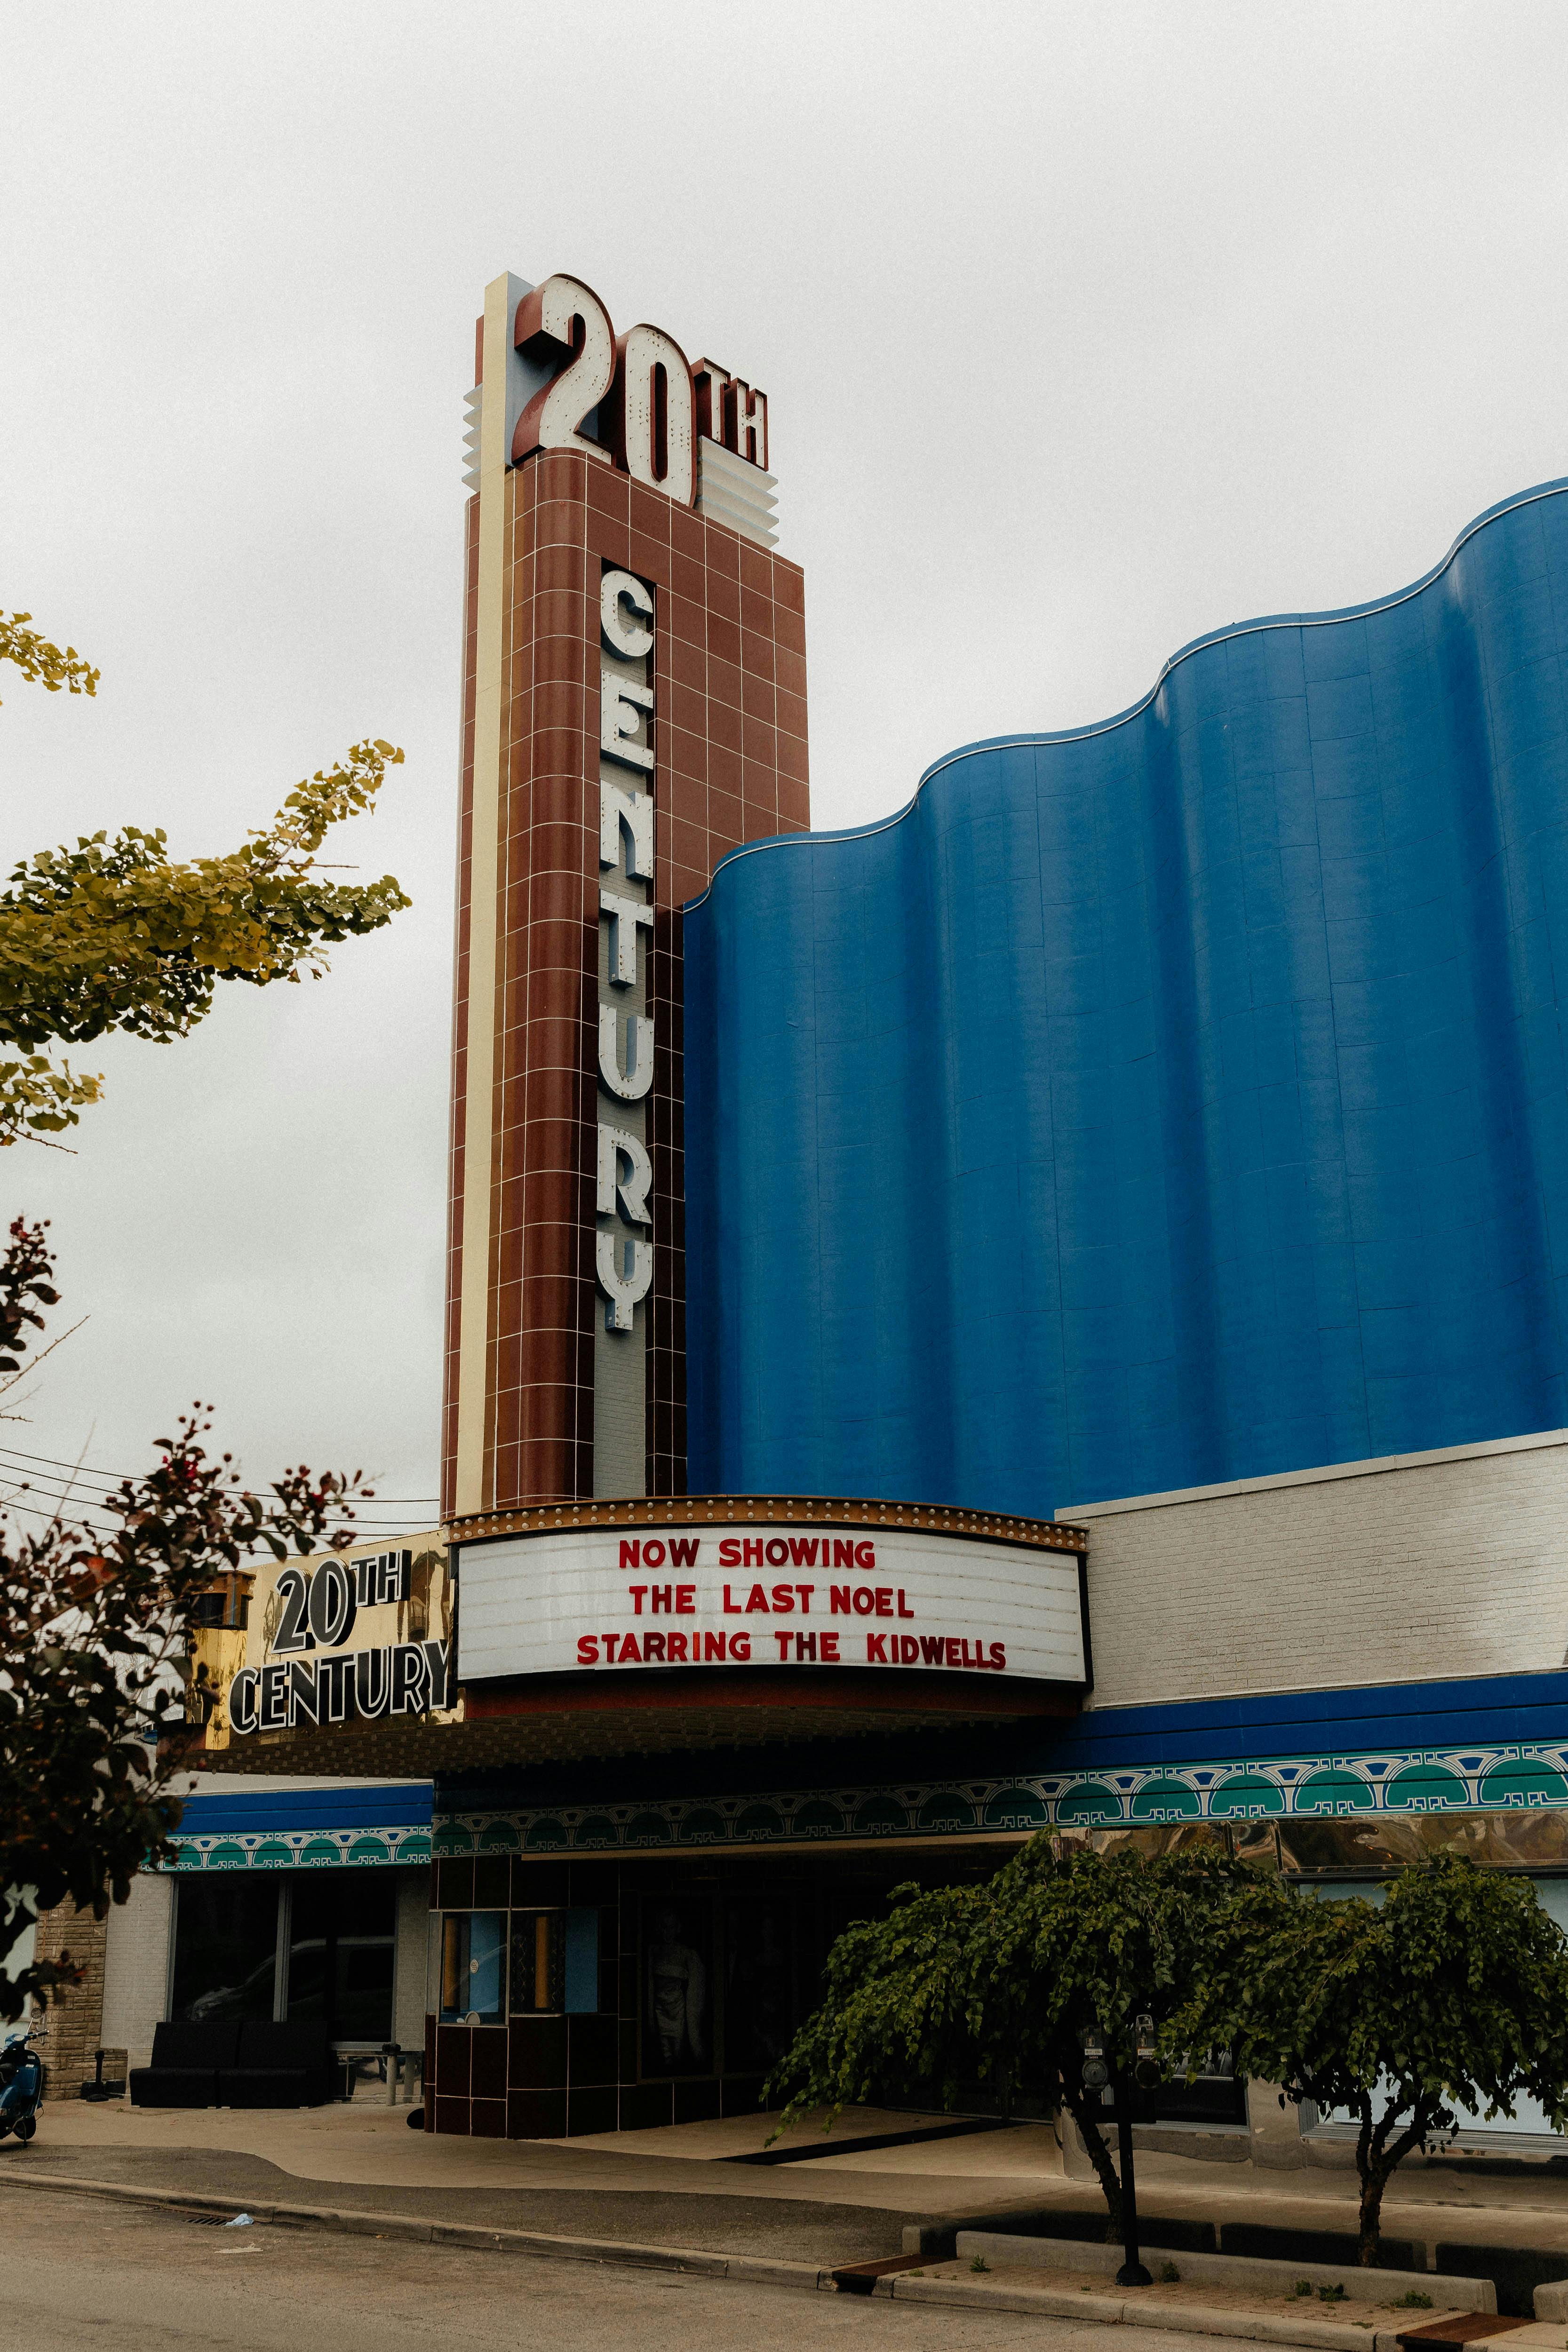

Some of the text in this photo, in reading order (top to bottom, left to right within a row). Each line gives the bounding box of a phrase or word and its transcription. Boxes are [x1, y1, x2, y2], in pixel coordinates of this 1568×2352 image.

[511, 273, 769, 509] 20TH
[596, 570, 654, 1331] CENTURY
[271, 1549, 406, 1654] 20TH
[619, 1537, 876, 1570] NOW SHOWING
[629, 1584, 915, 1619] THE LAST NOEL
[229, 1639, 450, 1735] CENTURY
[577, 1631, 1007, 1671] STARRING THE KIDWELLS
